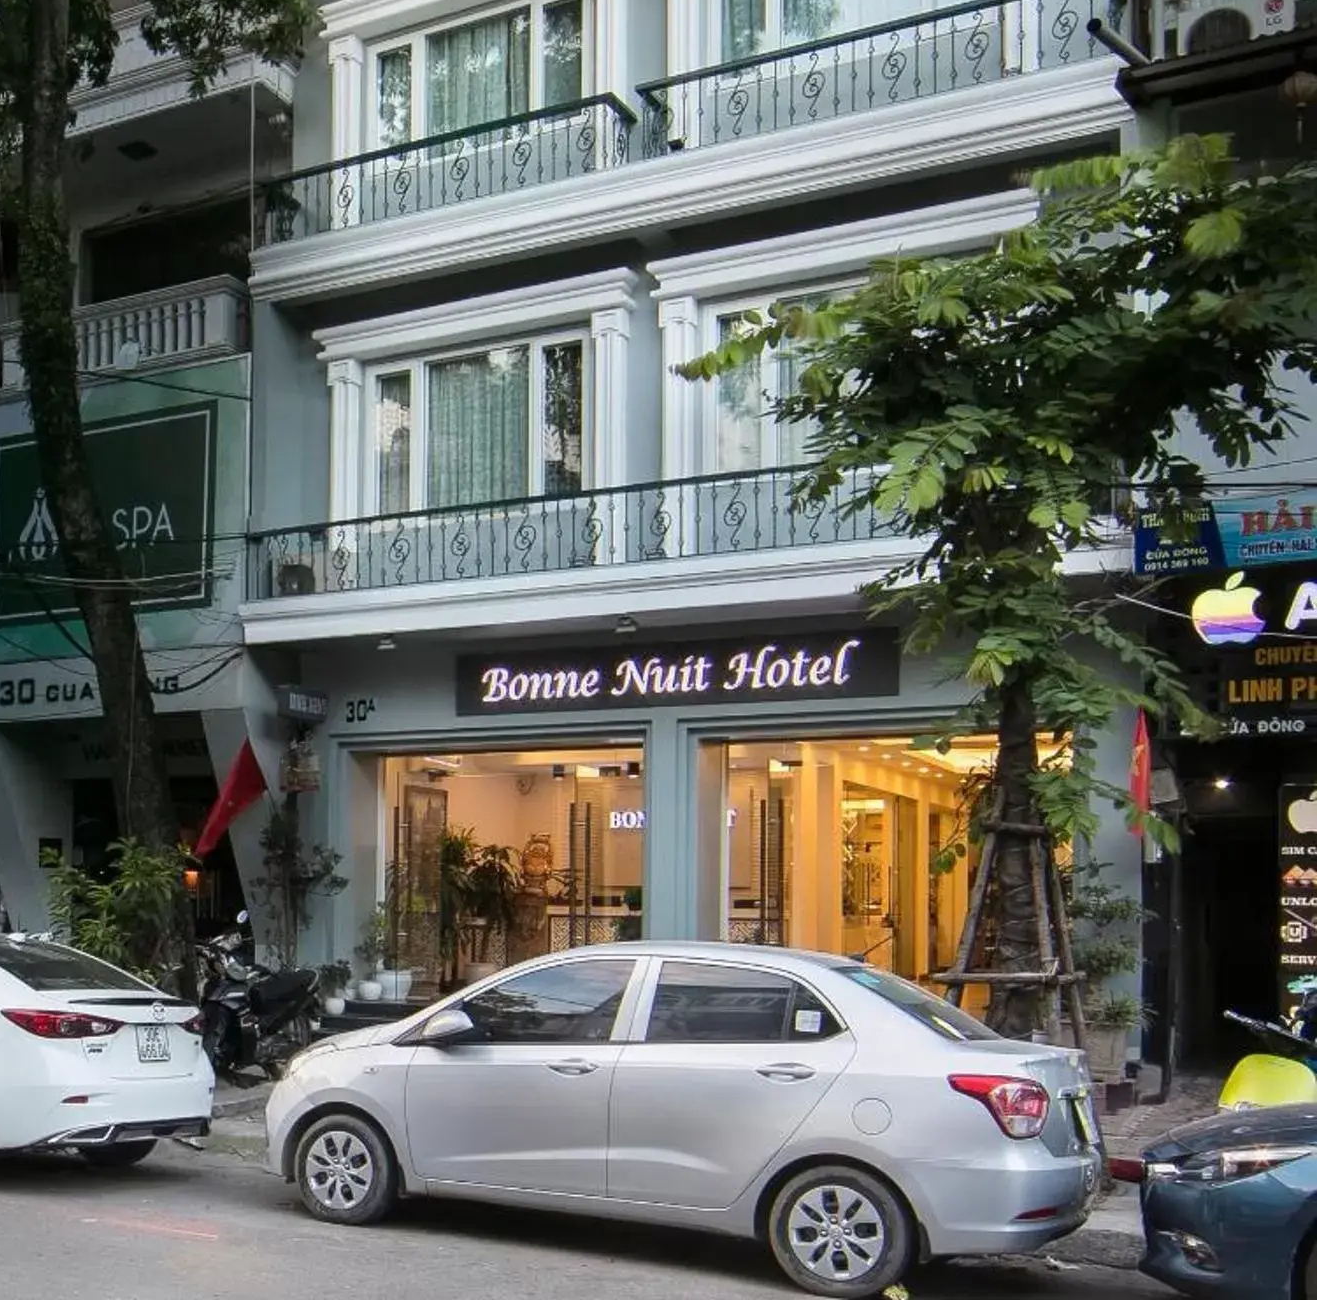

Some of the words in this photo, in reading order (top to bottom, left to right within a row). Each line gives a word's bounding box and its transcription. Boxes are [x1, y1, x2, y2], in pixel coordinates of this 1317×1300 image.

[112, 502, 174, 551] SPA
[481, 667, 601, 702] Bonne
[611, 655, 712, 696] Nuit
[723, 639, 861, 691] Hotel
[0, 679, 35, 706] 30
[1228, 678, 1283, 704] LINH
